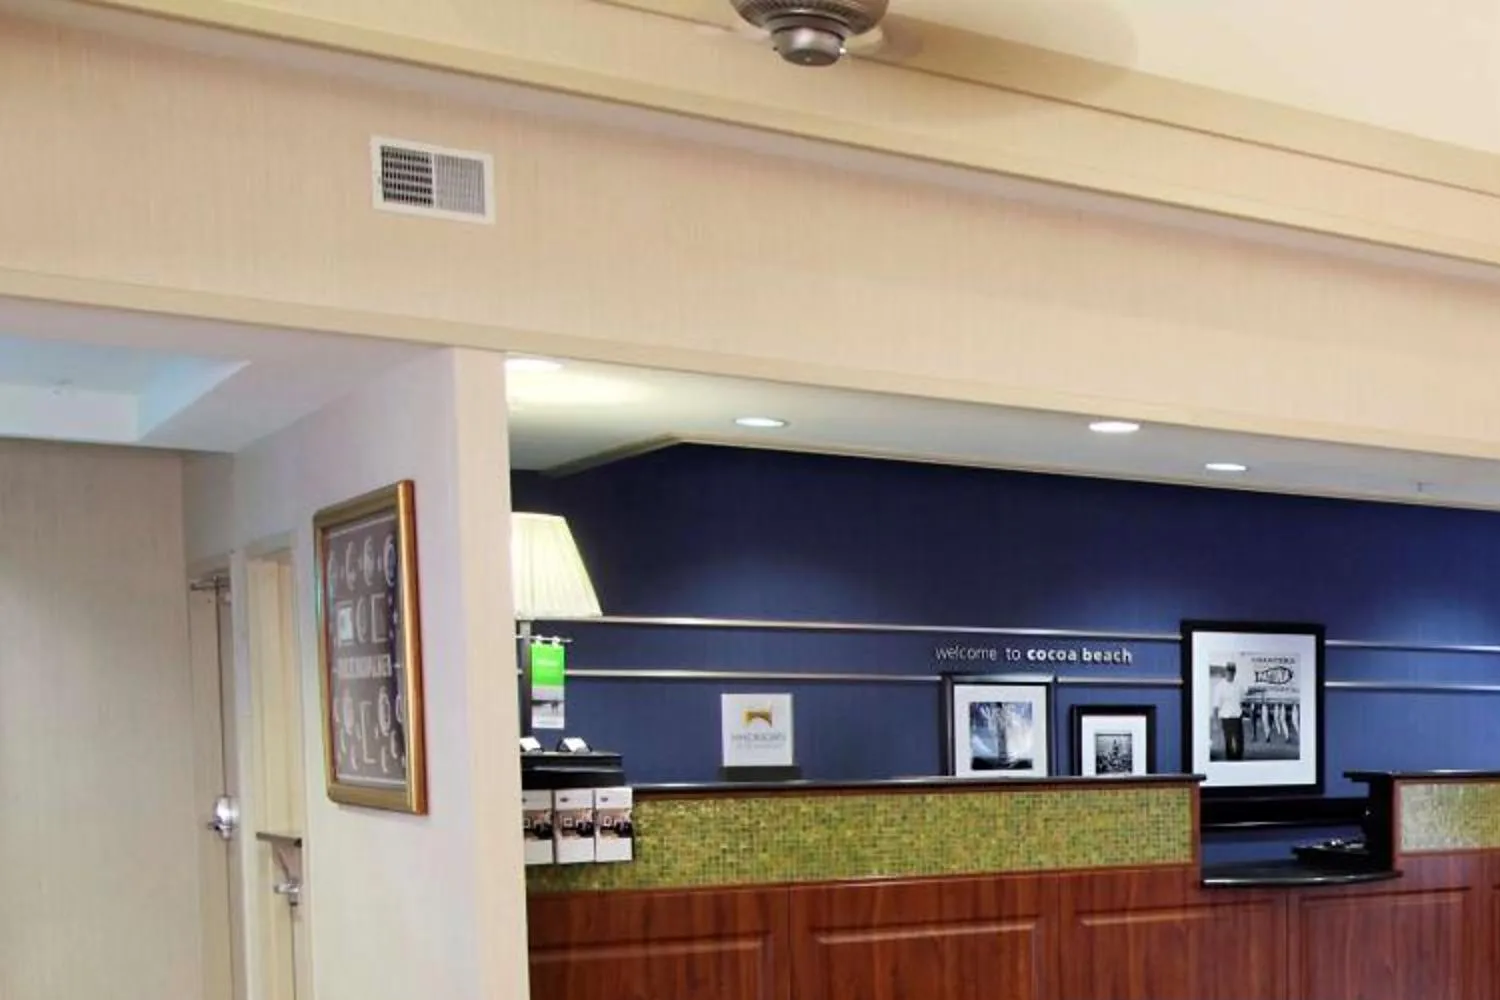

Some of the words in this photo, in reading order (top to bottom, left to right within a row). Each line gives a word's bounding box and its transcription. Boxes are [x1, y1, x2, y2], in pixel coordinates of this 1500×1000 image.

[935, 645, 998, 661] welcome
[1004, 647, 1022, 662] to
[1026, 647, 1077, 662] cocoa
[1081, 647, 1133, 665] beach
